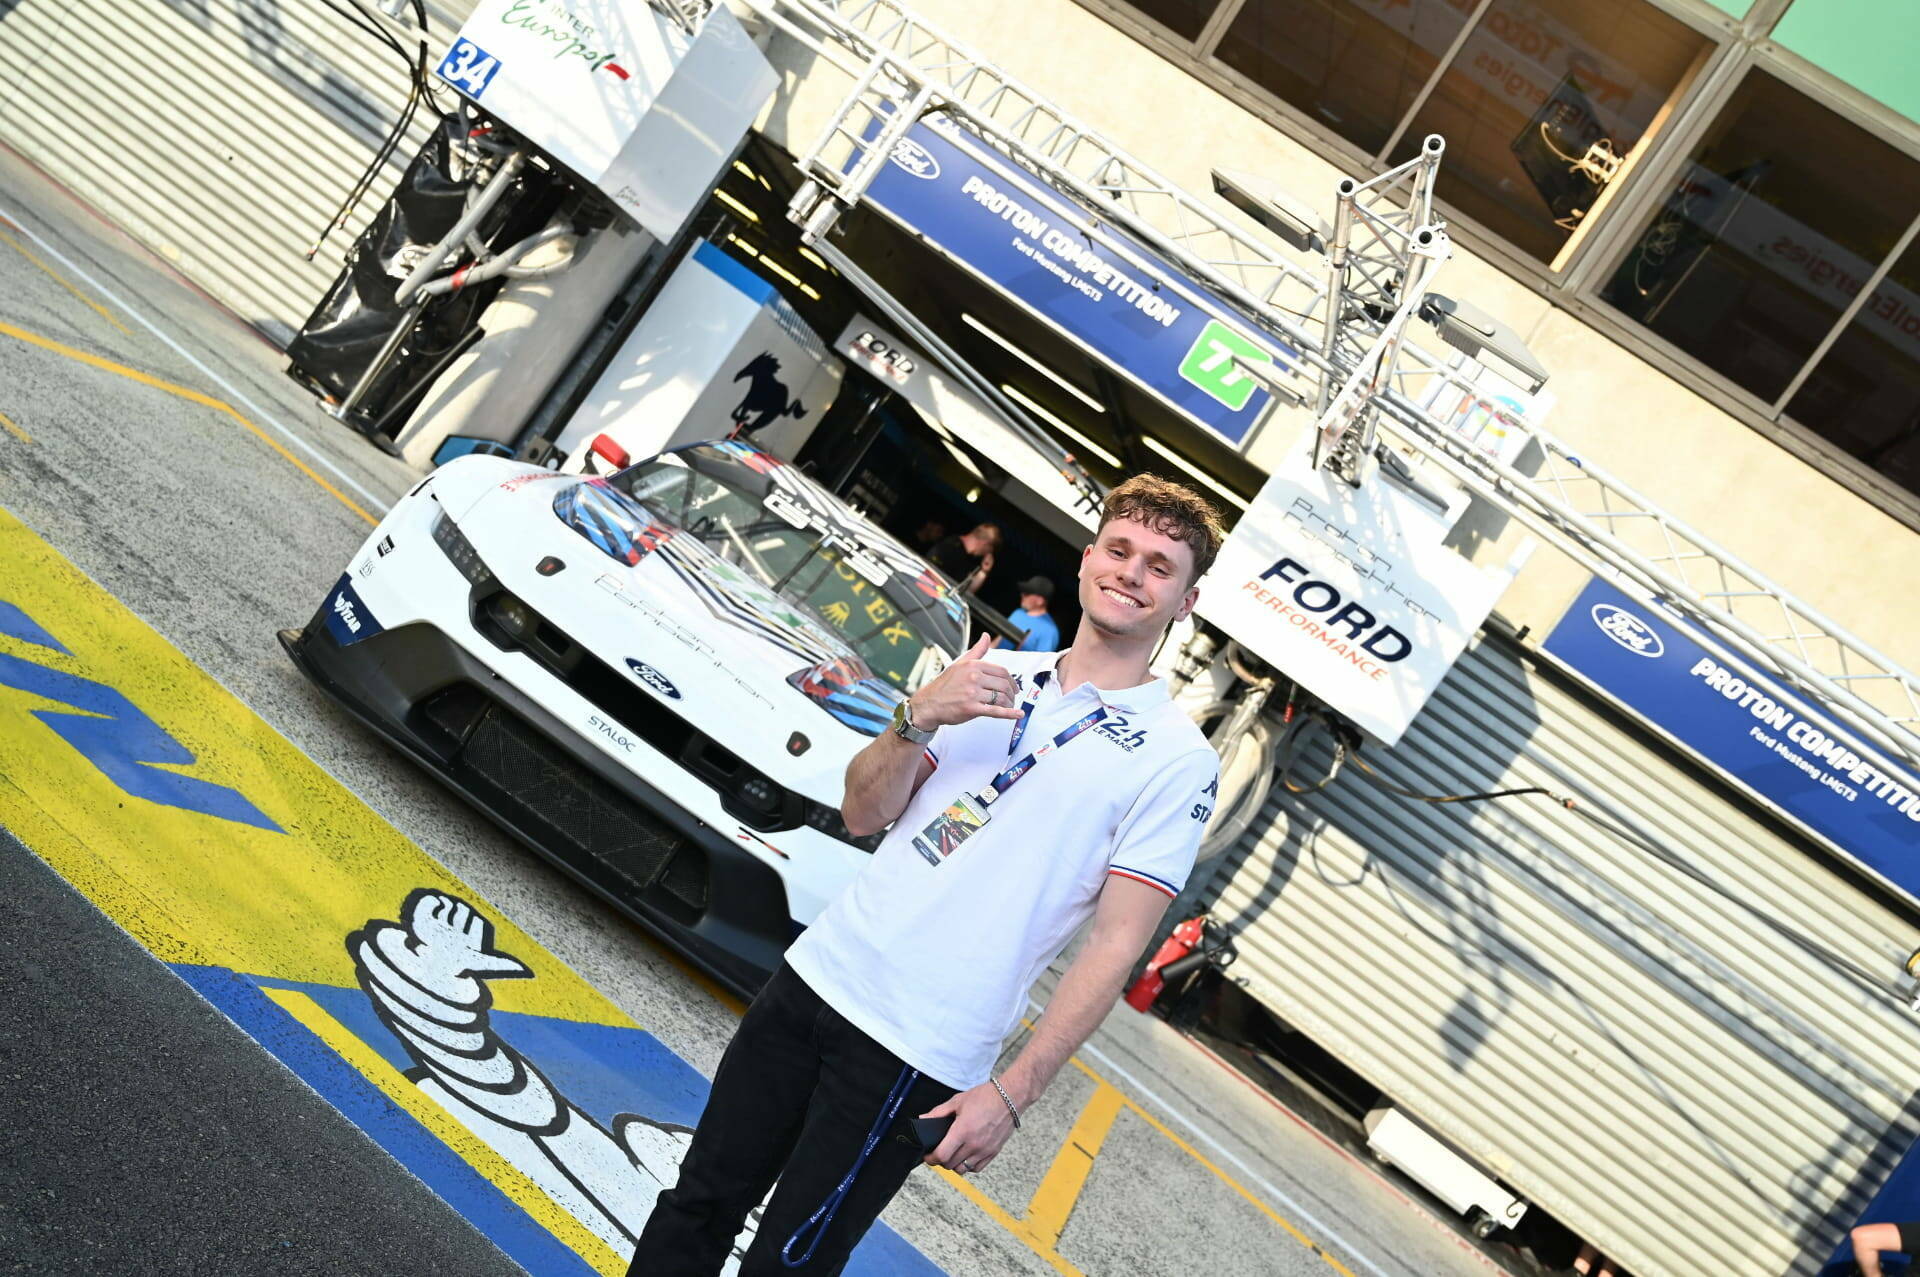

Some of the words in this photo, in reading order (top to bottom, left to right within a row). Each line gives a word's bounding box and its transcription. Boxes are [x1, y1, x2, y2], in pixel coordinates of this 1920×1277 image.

[502, 0, 616, 72] Europol
[552, 5, 595, 38] INTER
[443, 42, 497, 94] 34
[962, 175, 1048, 240] PROTON
[1042, 229, 1182, 327] COMPETITION
[1012, 237, 1035, 257] Ford
[1032, 248, 1073, 284] Mustang
[856, 331, 915, 374] FORD
[1292, 497, 1392, 572] Proton
[1243, 580, 1392, 682] PERFORMANCE
[1259, 557, 1413, 663] FORD
[588, 715, 637, 753] STALOC
[1092, 726, 1106, 735] LE
[1104, 733, 1134, 752] MANS
[1689, 656, 1795, 731] PROTON
[1786, 720, 1920, 823] COMPETITIO
[1749, 726, 1777, 749] Ford
[1774, 742, 1822, 780] Mustang
[1819, 771, 1859, 802] LMGT3
